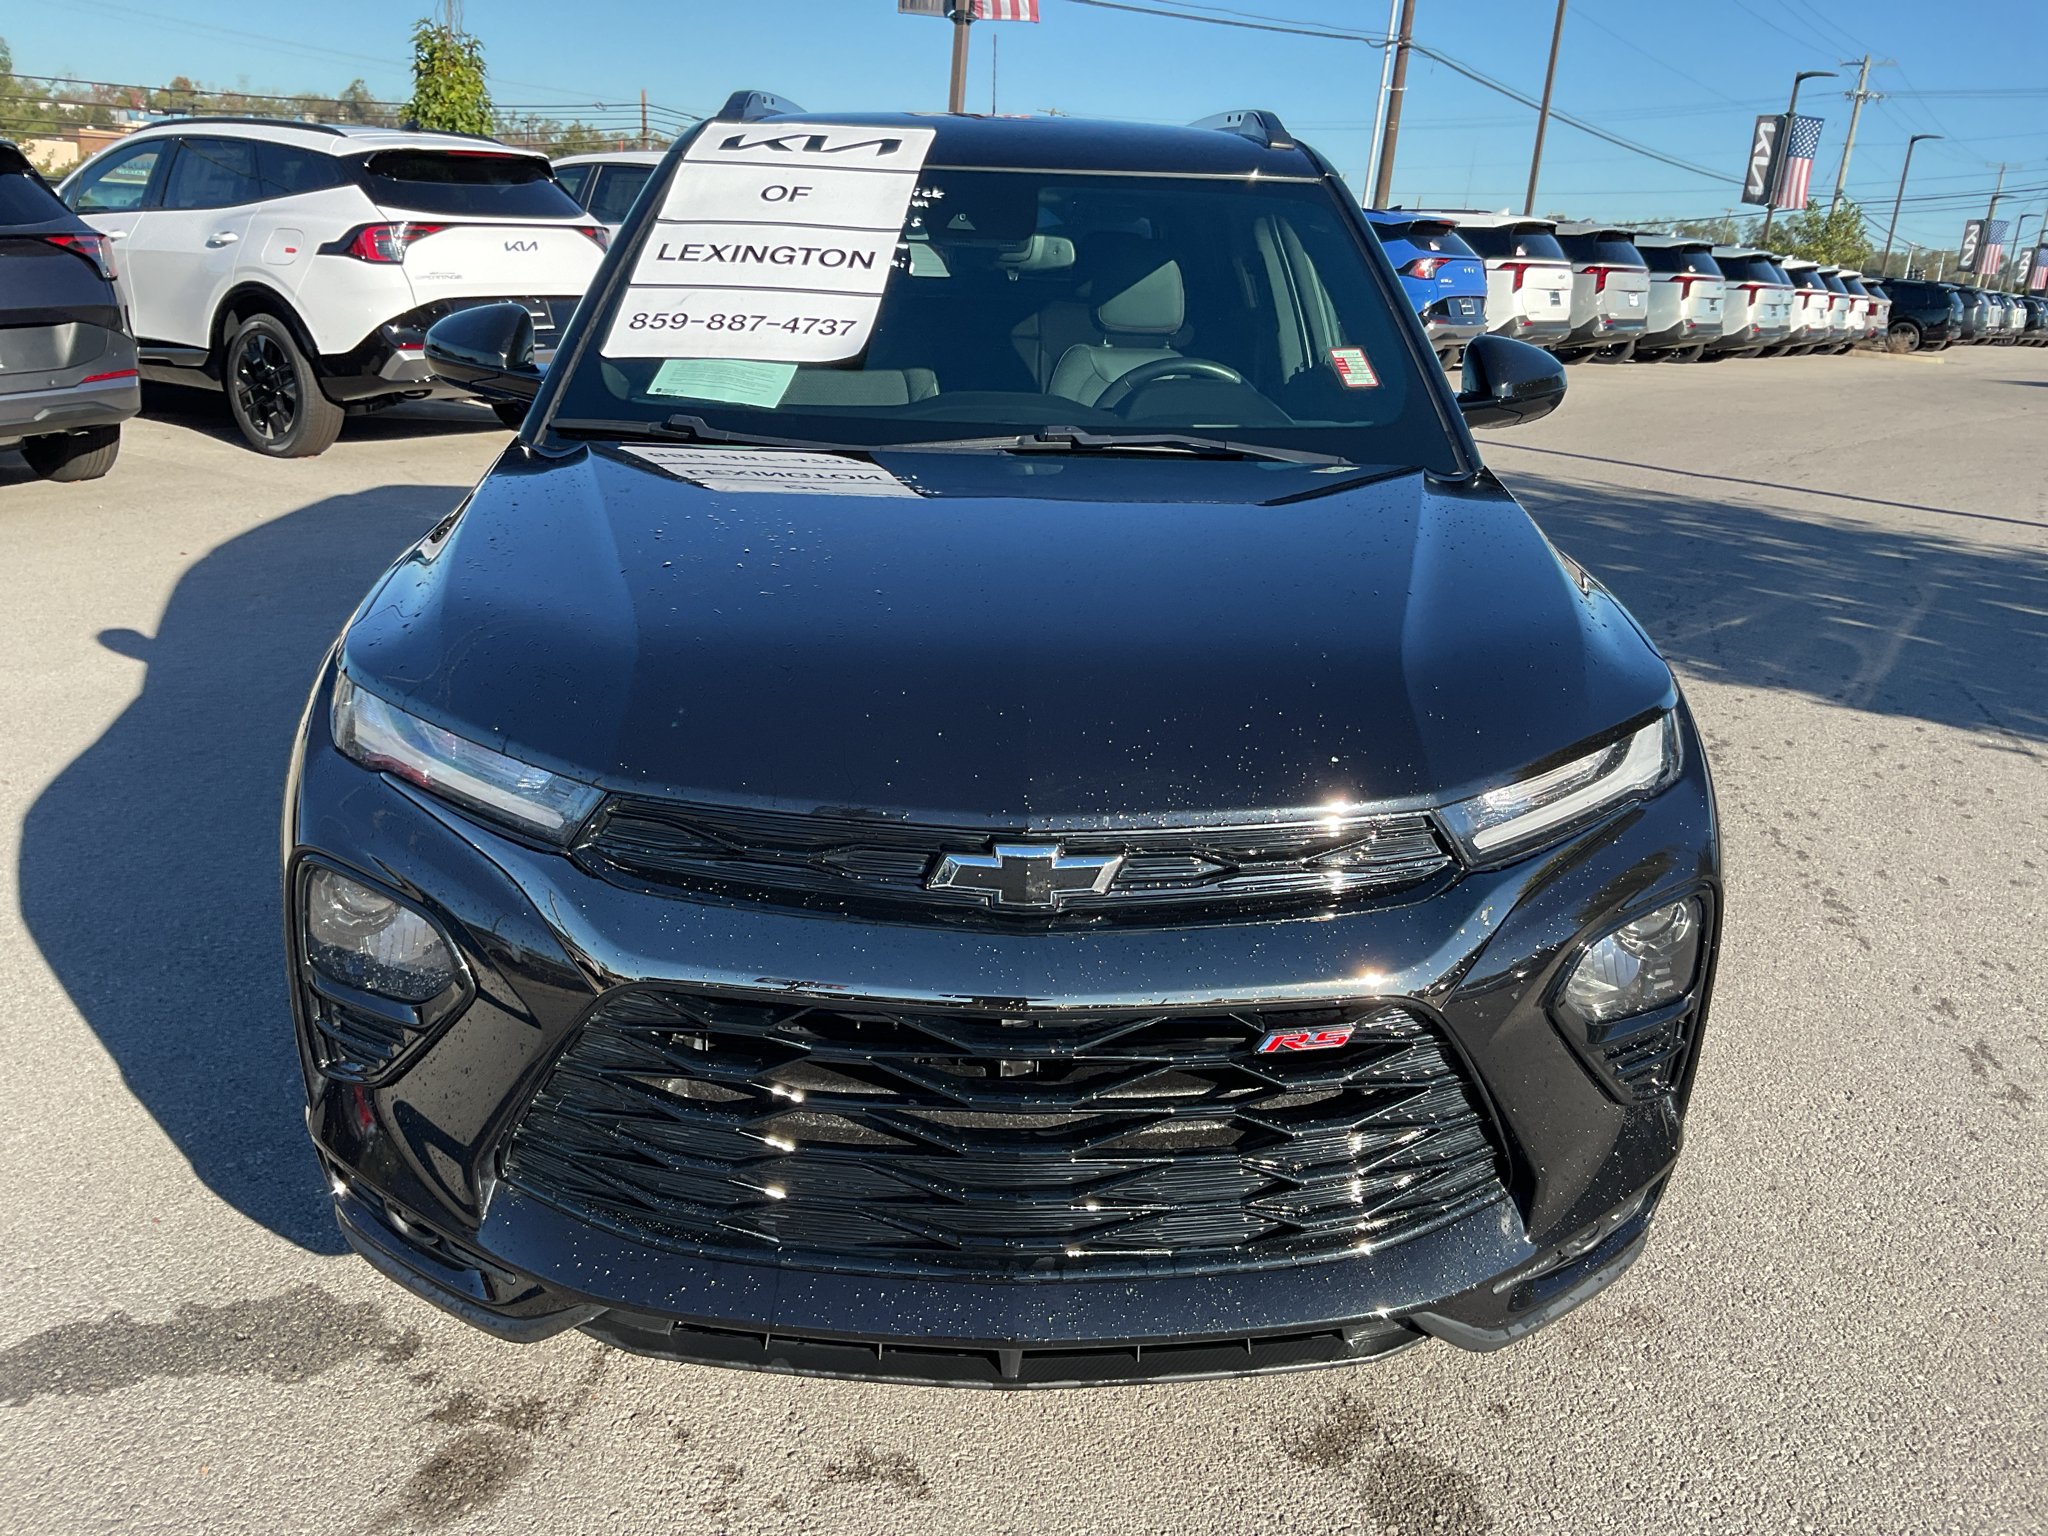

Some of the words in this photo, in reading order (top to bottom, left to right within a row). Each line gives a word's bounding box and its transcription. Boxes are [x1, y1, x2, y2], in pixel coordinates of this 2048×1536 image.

[718, 134, 903, 156] KIA
[1748, 122, 1776, 195] KIA
[760, 185, 813, 202] OF
[504, 240, 539, 252] KIA
[656, 243, 876, 270] LEXINGTON
[628, 312, 858, 337] 859-887-4737
[1262, 1028, 1353, 1053] RS
